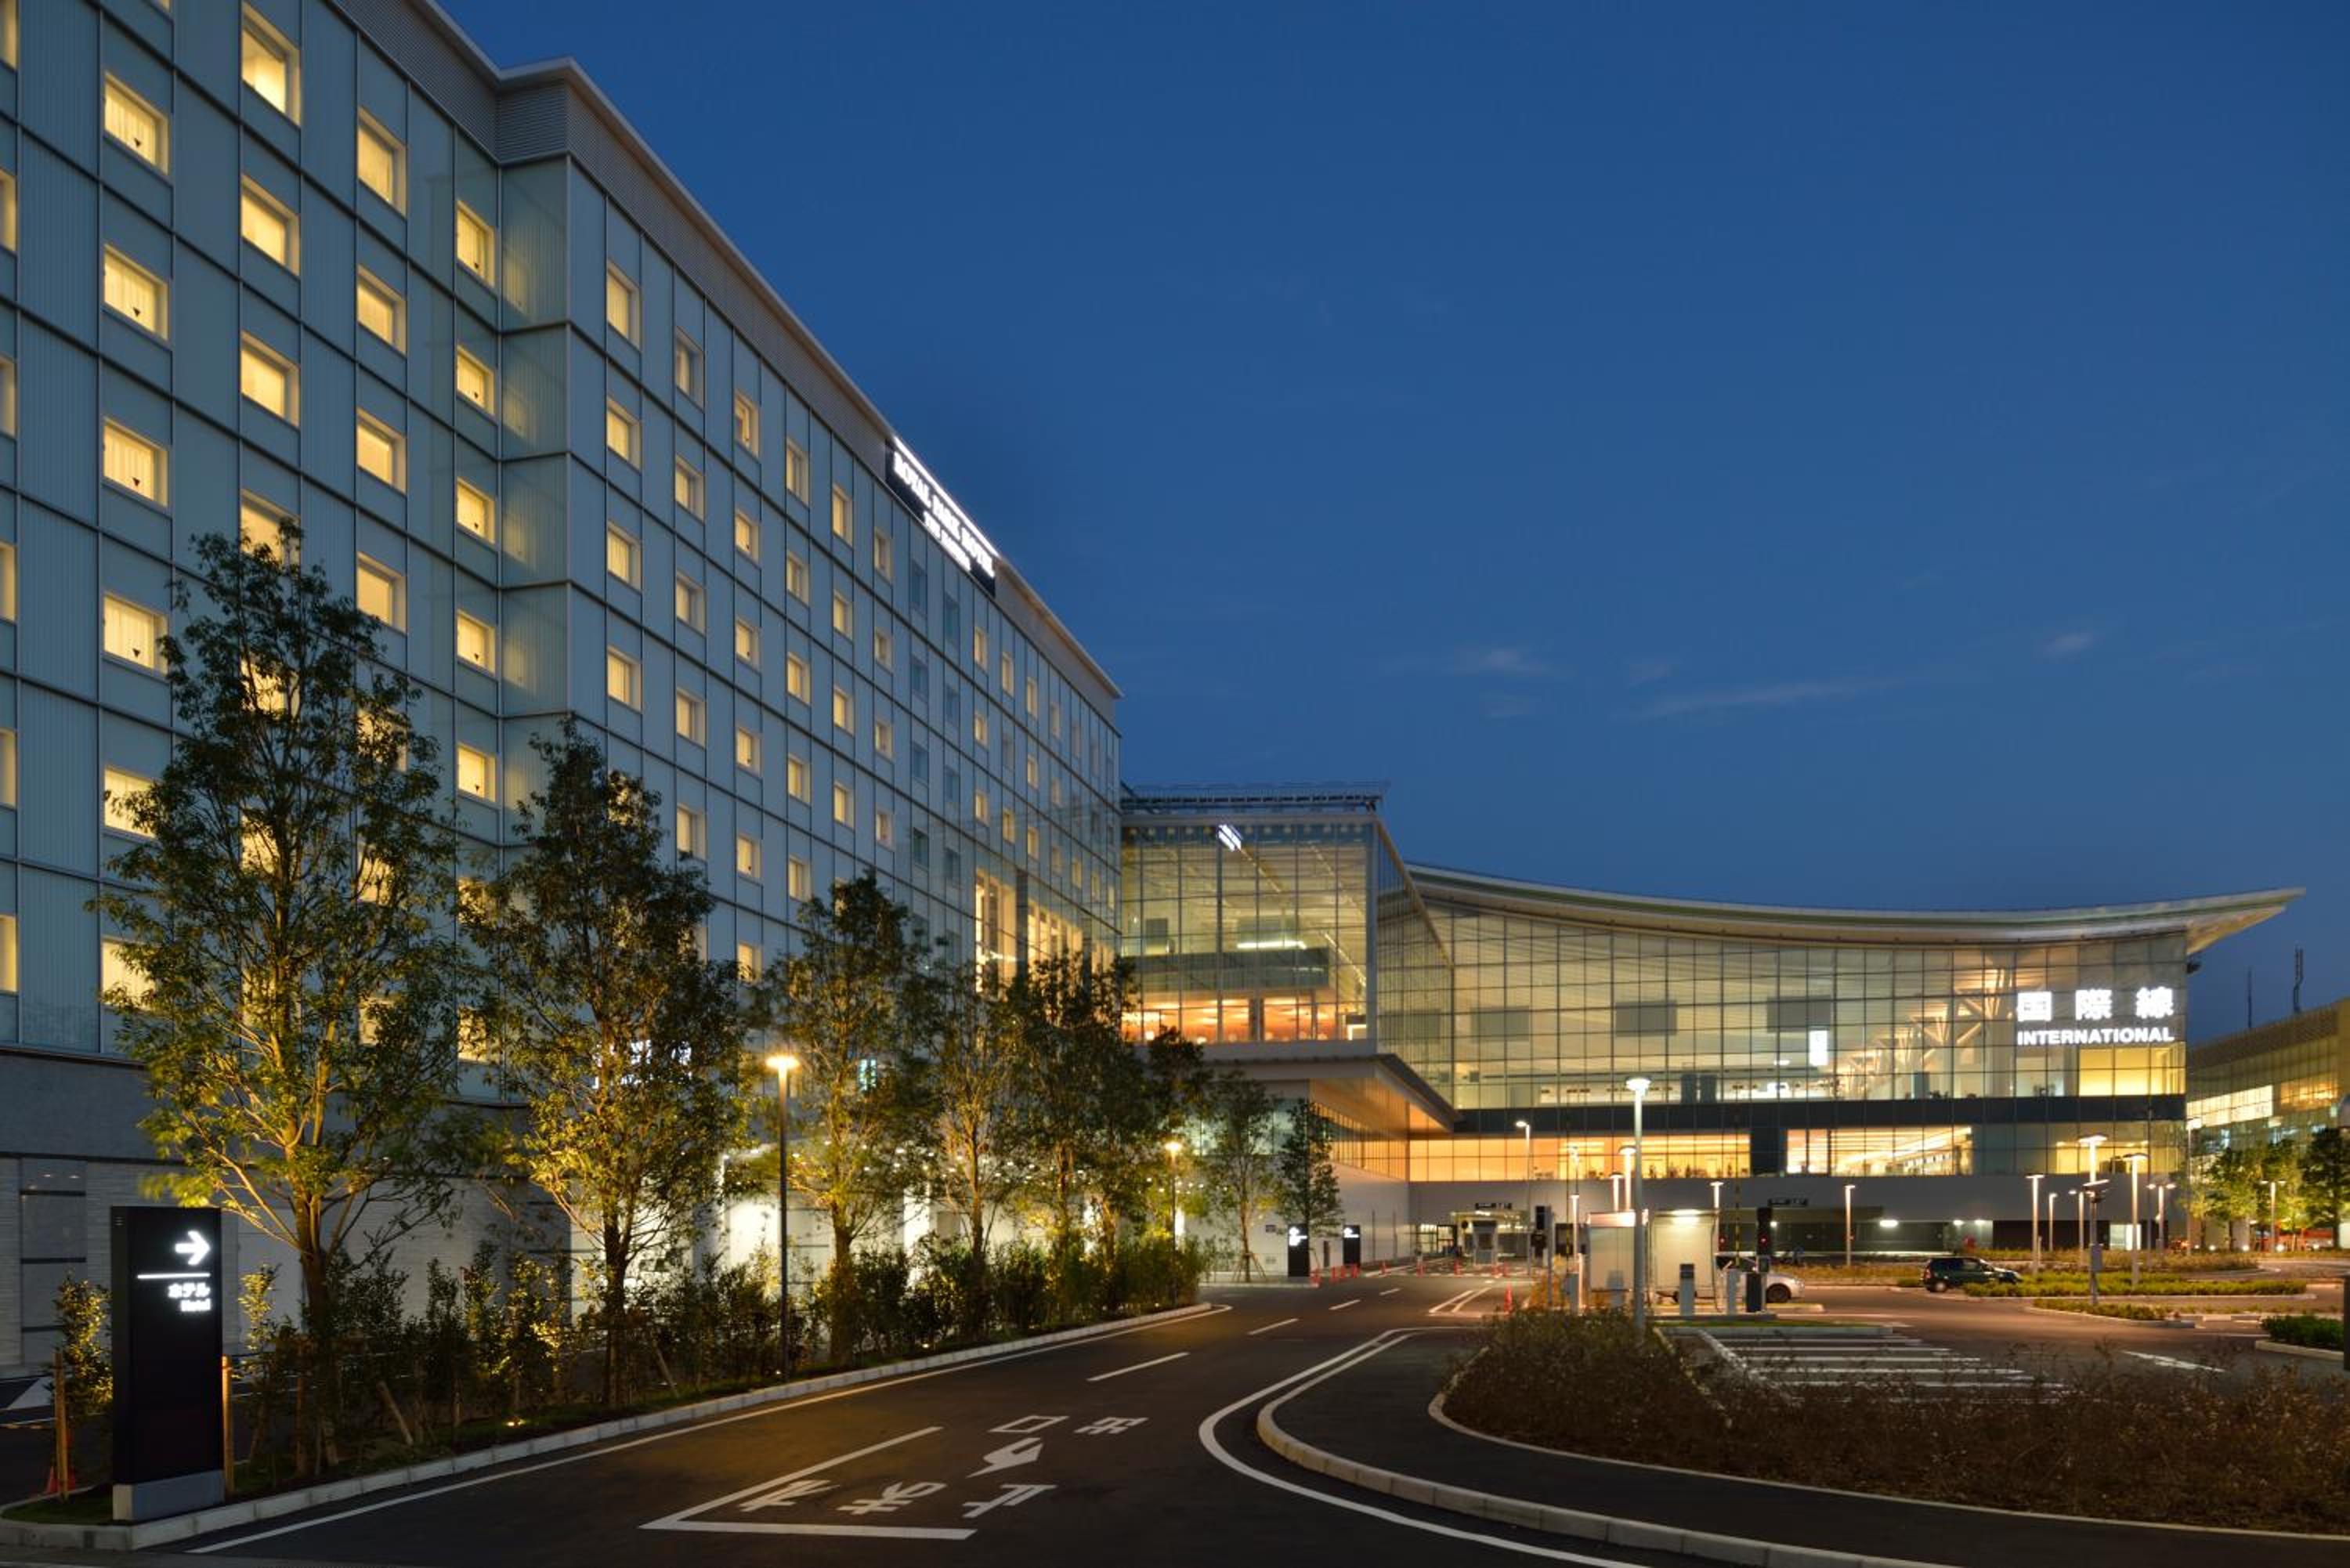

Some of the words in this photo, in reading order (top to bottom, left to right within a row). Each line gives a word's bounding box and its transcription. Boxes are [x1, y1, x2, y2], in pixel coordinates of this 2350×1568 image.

[2016, 1027, 2175, 1046] INTERNATIONAL
[168, 1281, 211, 1299] ホテル
